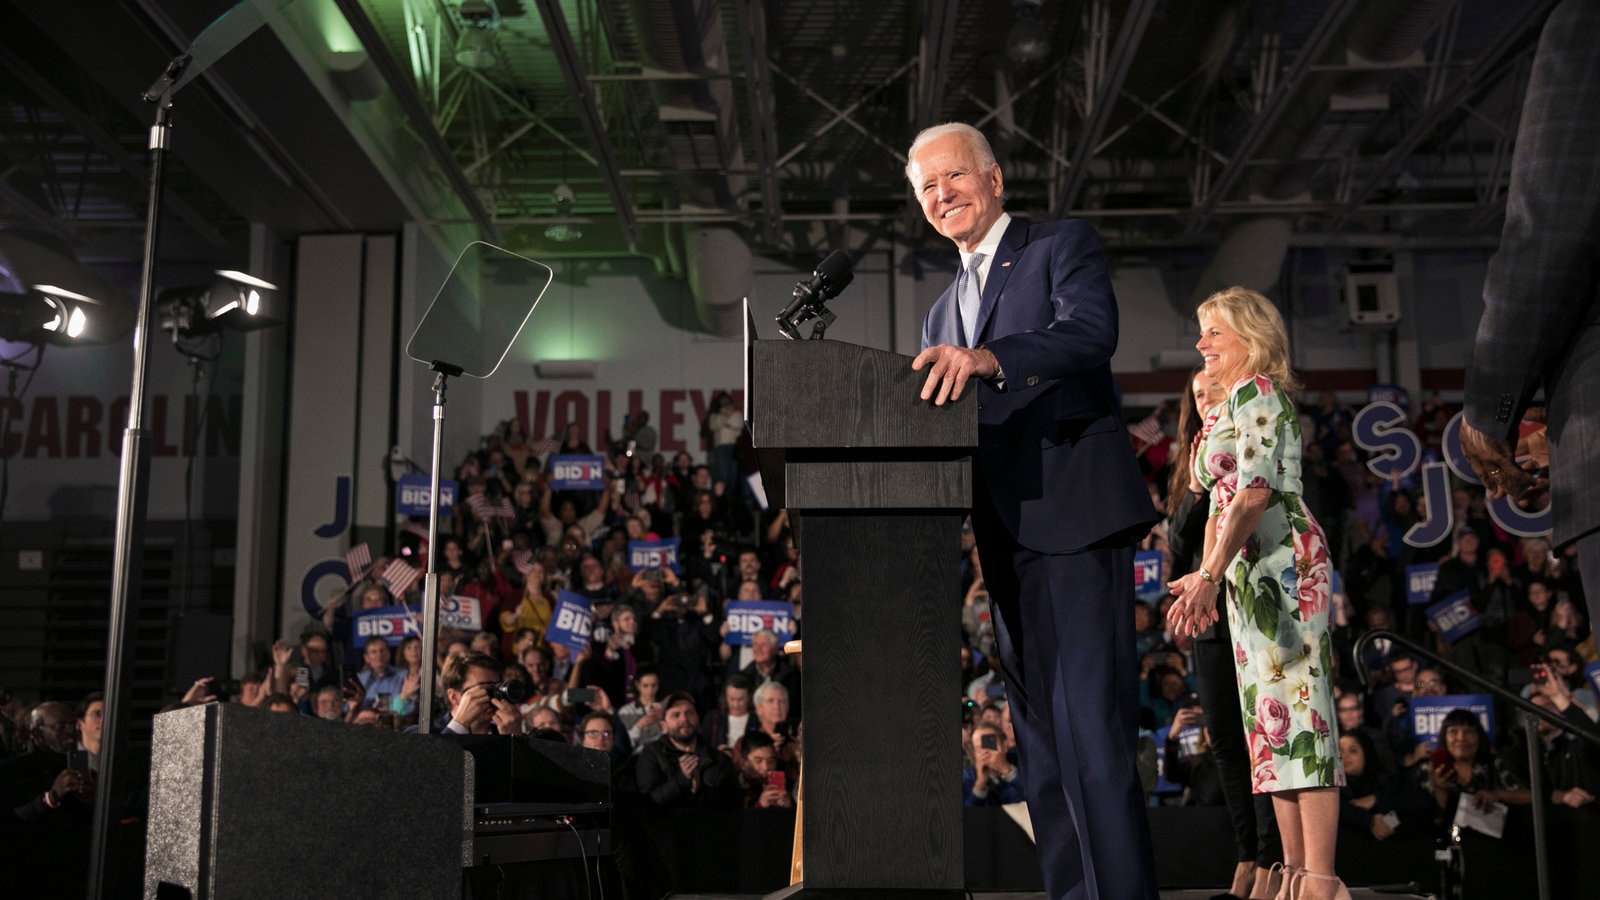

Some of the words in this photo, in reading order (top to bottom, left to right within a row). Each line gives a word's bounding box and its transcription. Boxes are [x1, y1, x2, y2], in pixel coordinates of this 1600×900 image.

[514, 389, 744, 452] VOLLEY
[402, 490, 453, 506] BIDN
[357, 617, 418, 636] BIDEN
[556, 608, 592, 636] BID
[728, 615, 788, 634] BIDEN
[1437, 602, 1479, 632] BID
